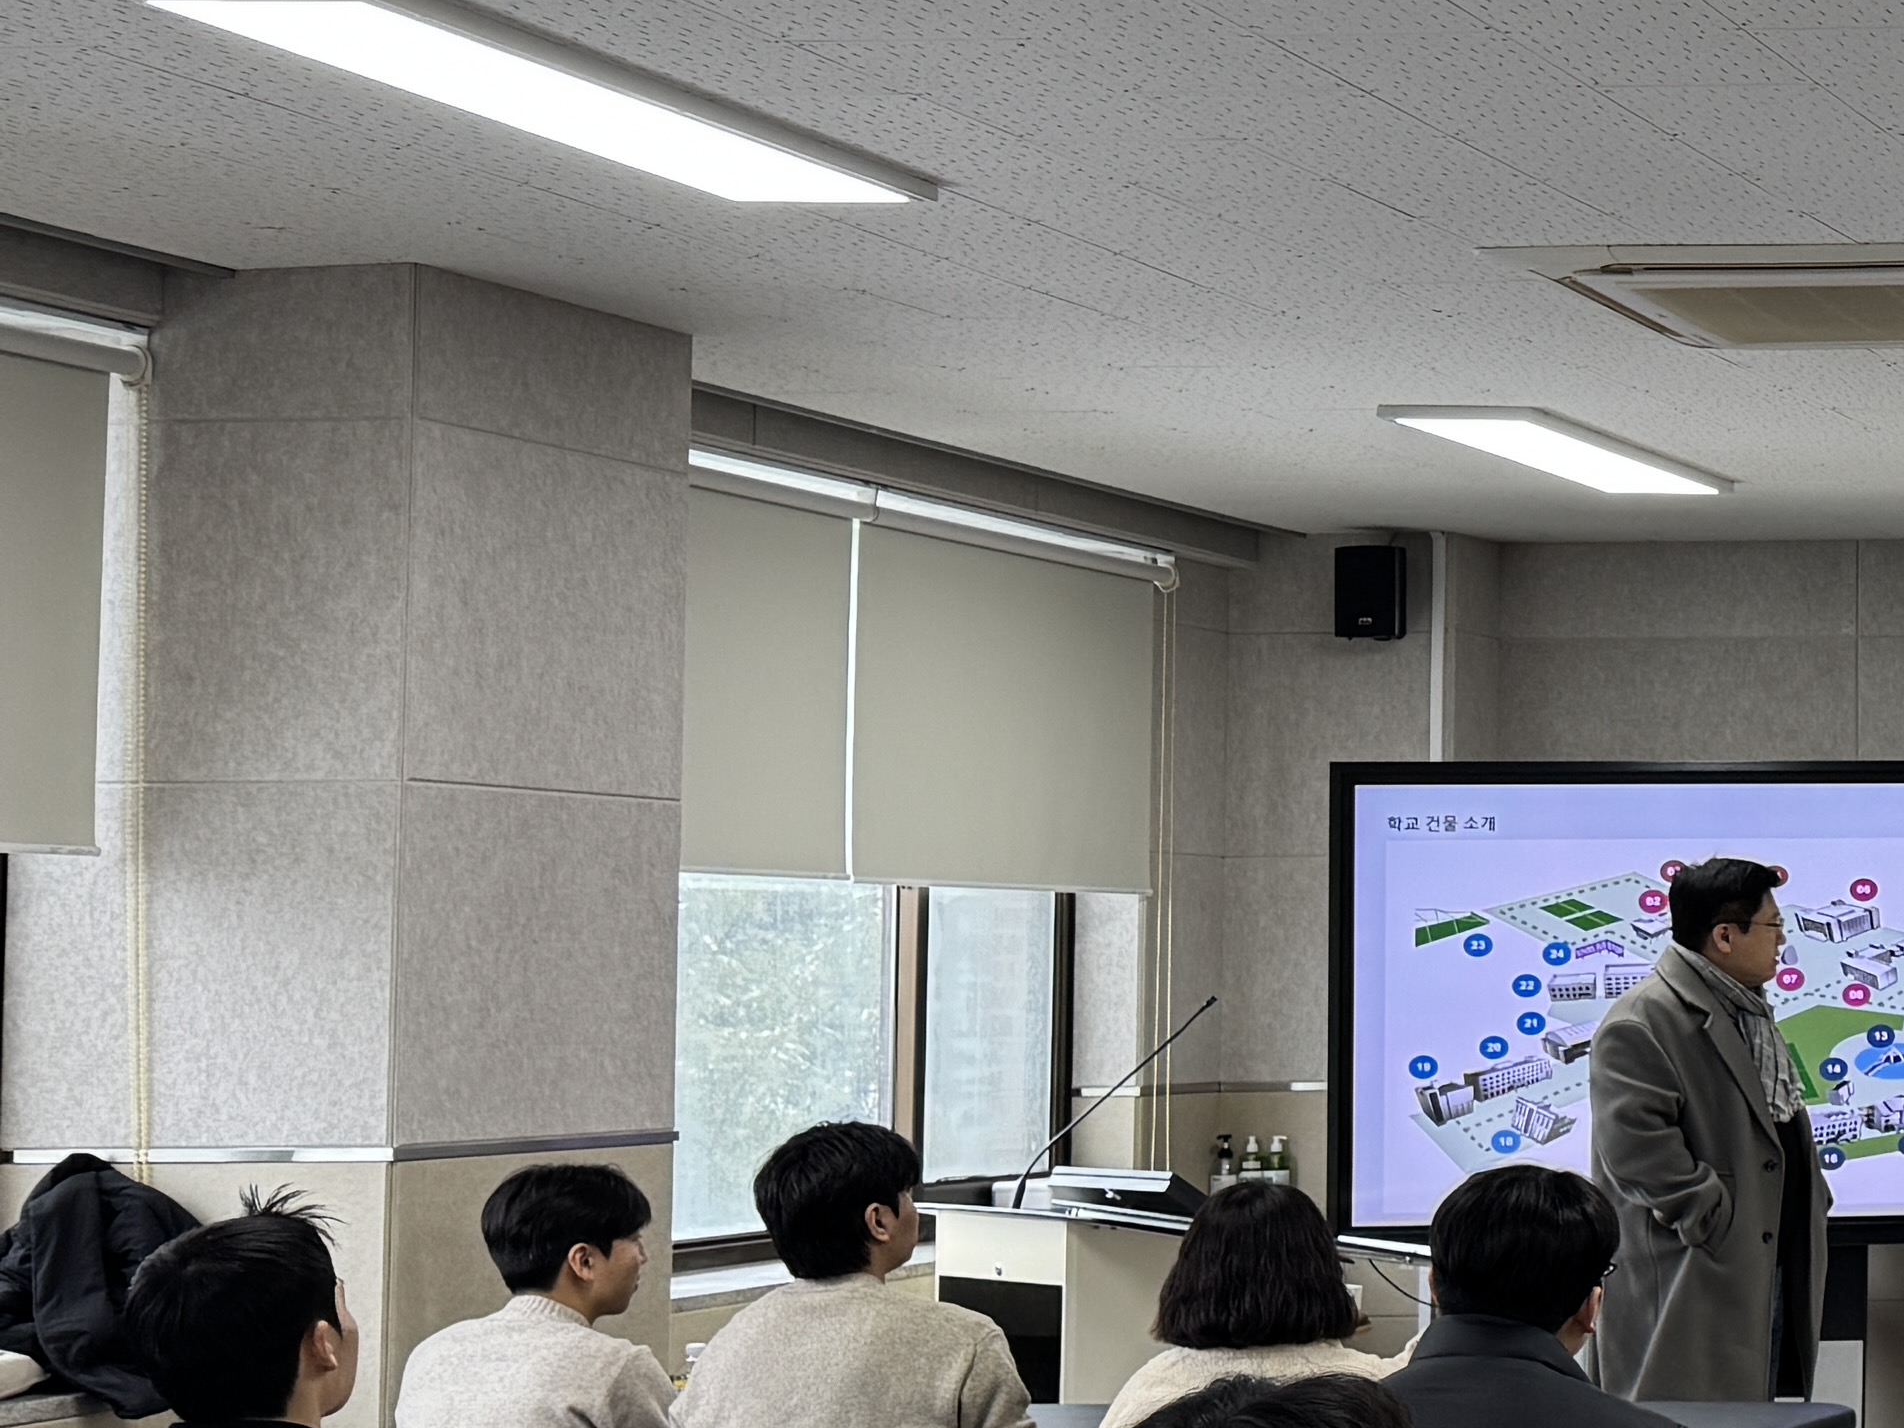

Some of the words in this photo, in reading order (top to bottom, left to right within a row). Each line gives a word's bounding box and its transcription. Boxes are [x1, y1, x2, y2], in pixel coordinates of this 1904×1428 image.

[1387, 815, 1420, 832] 학교
[1425, 815, 1458, 832] 건물
[1463, 815, 1496, 832] 소개
